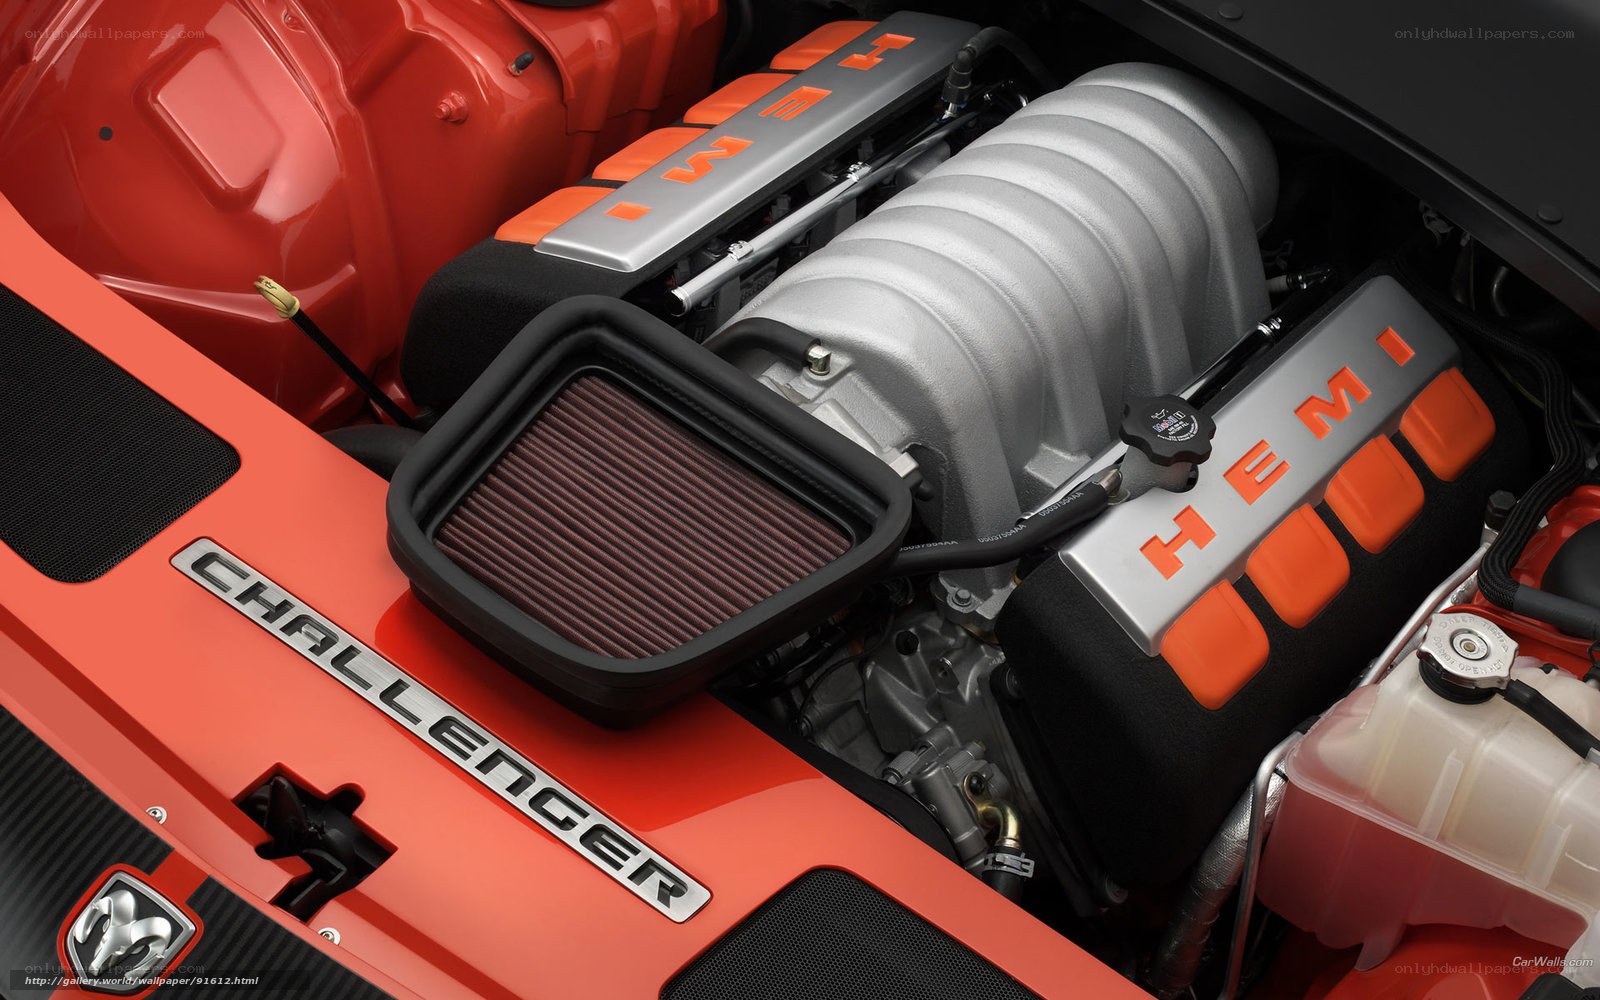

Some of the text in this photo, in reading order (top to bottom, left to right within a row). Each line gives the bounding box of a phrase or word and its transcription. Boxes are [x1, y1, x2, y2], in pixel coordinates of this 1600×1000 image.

[604, 33, 916, 222] HEMI
[1139, 326, 1416, 581] HEMI
[1152, 415, 1179, 432] Mobil
[191, 552, 688, 909] CHALLENGER
